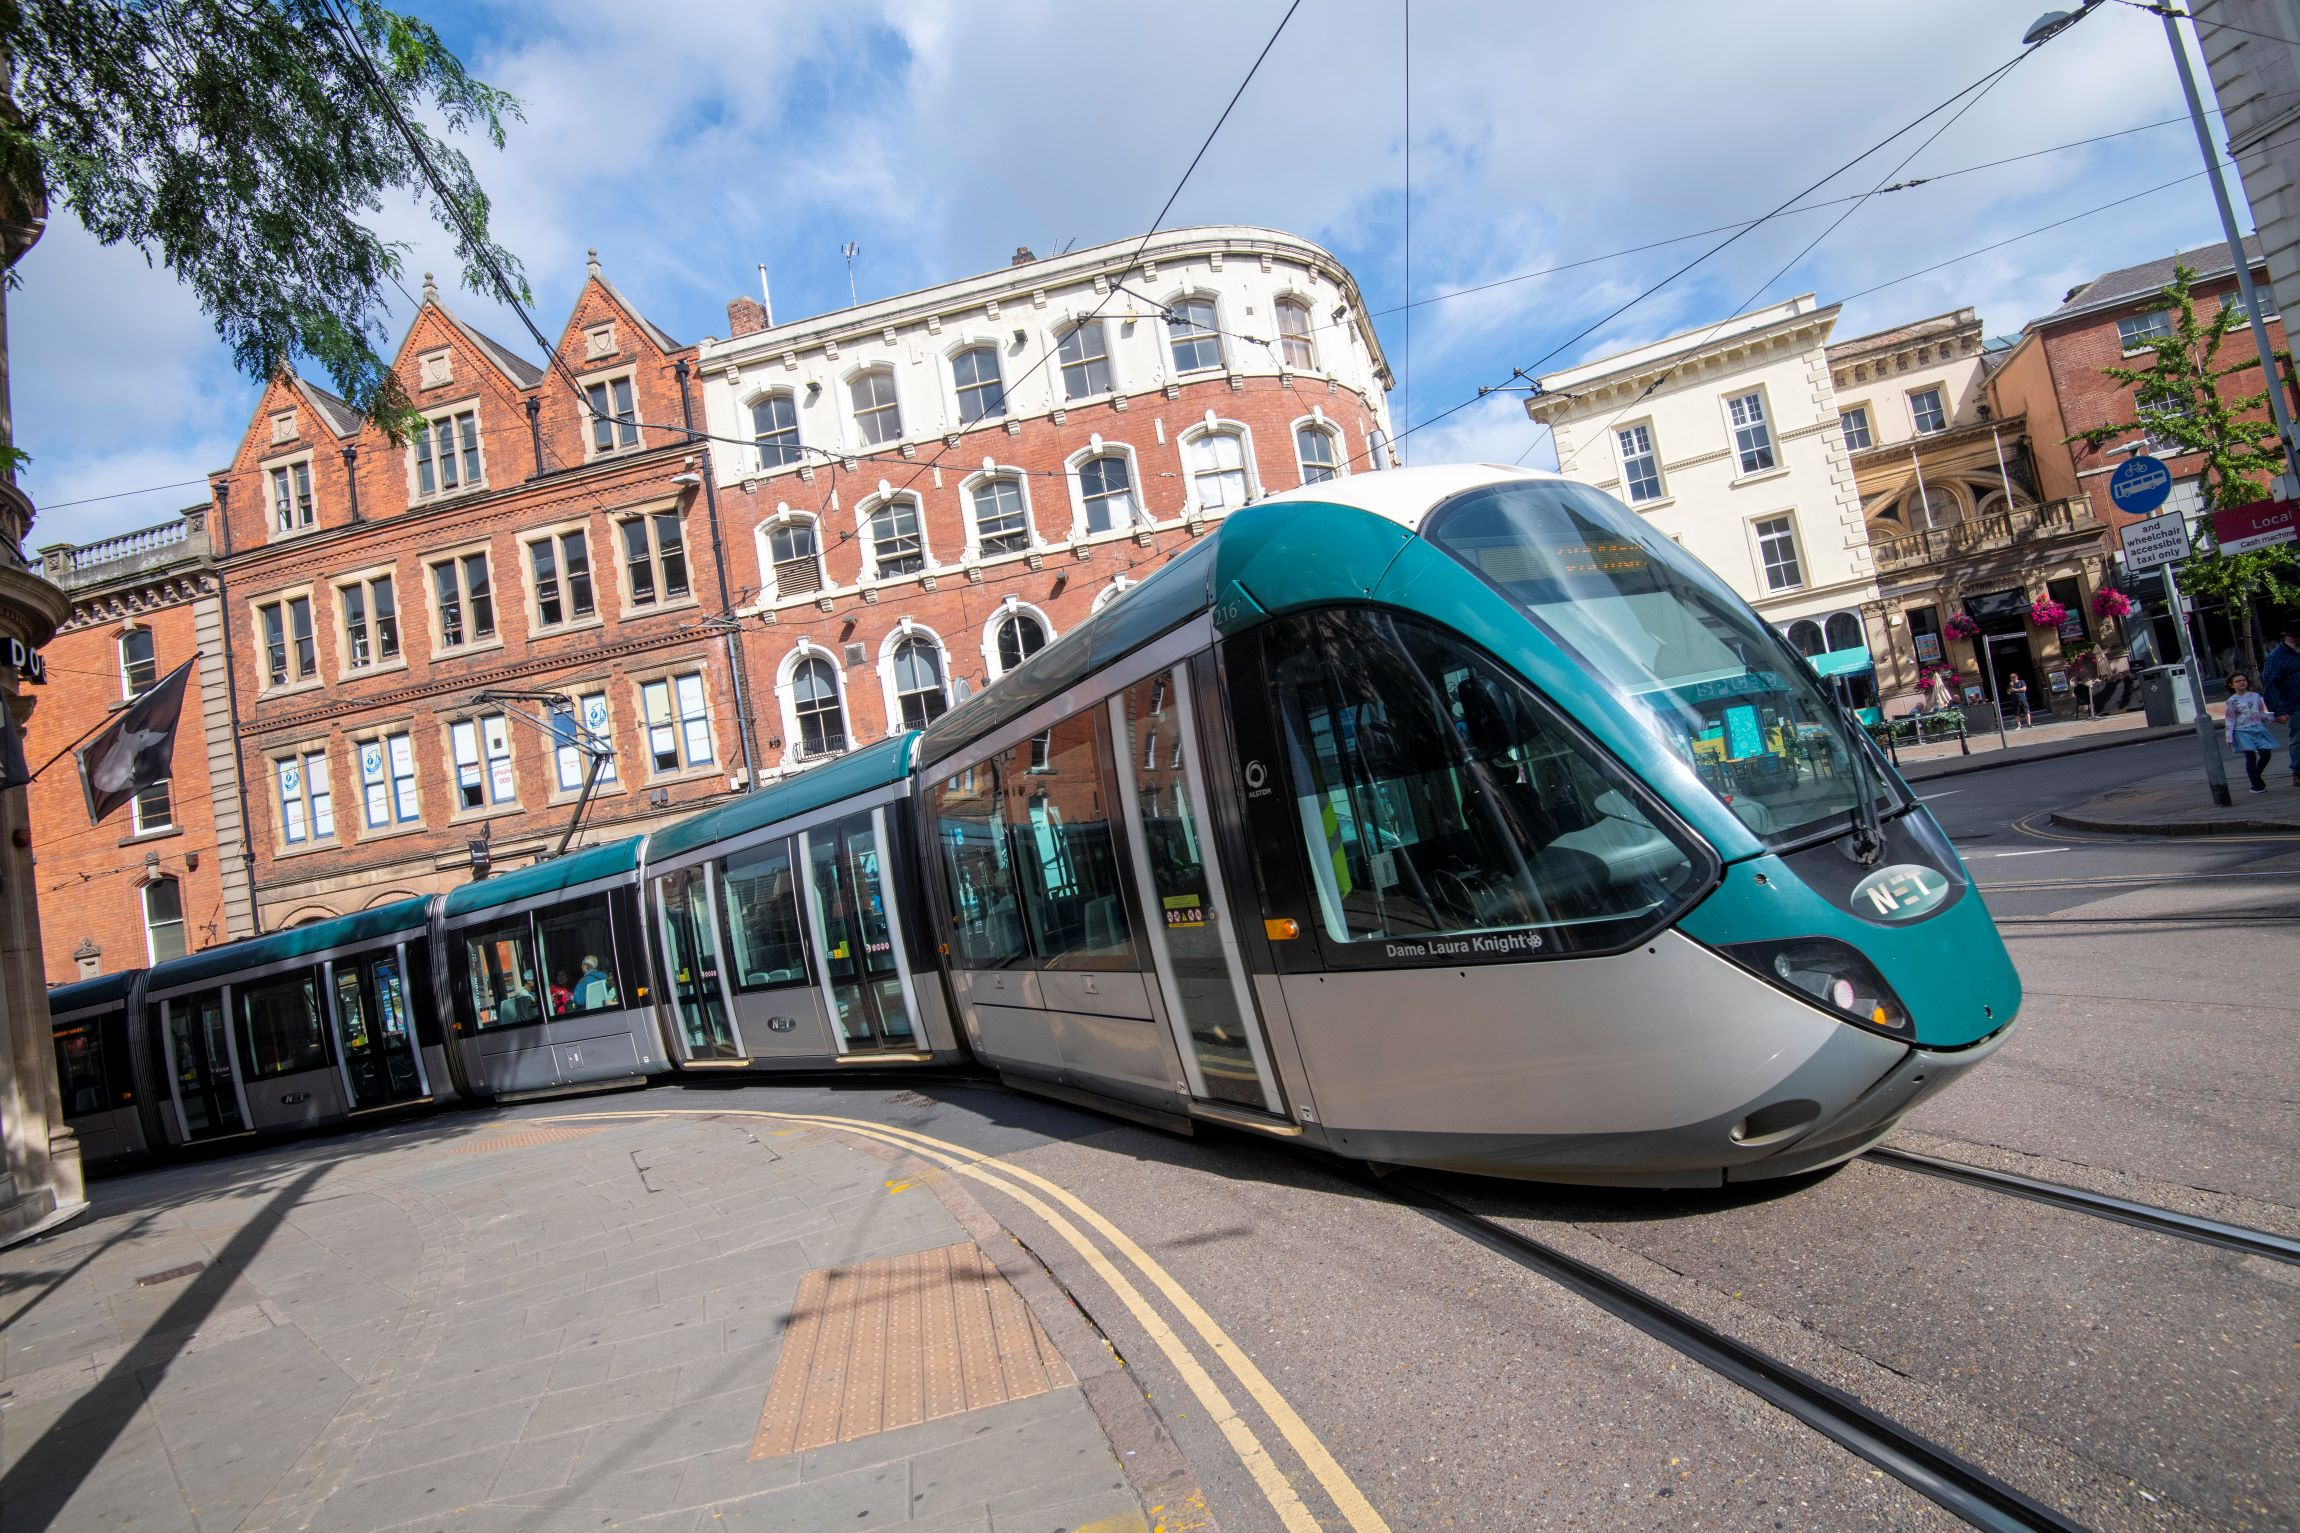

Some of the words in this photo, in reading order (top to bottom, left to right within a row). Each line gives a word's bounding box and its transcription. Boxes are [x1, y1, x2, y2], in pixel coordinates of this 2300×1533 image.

[2142, 521, 2161, 533] and
[2252, 508, 2293, 530] Local
[2127, 527, 2181, 547] wheelchair
[2130, 537, 2183, 556] accessible
[2240, 538, 2261, 548] Cash
[2262, 529, 2297, 544] machine
[2137, 553, 2156, 564] taxi
[2158, 548, 2180, 559] only
[1214, 601, 1238, 626] 216
[1248, 787, 1272, 799] ALSTOM
[1866, 869, 1931, 915] NET
[1386, 943, 1426, 957] Dame
[1428, 941, 1470, 955] Laura
[1472, 934, 1527, 953] Knight
[772, 1018, 791, 1030] NET
